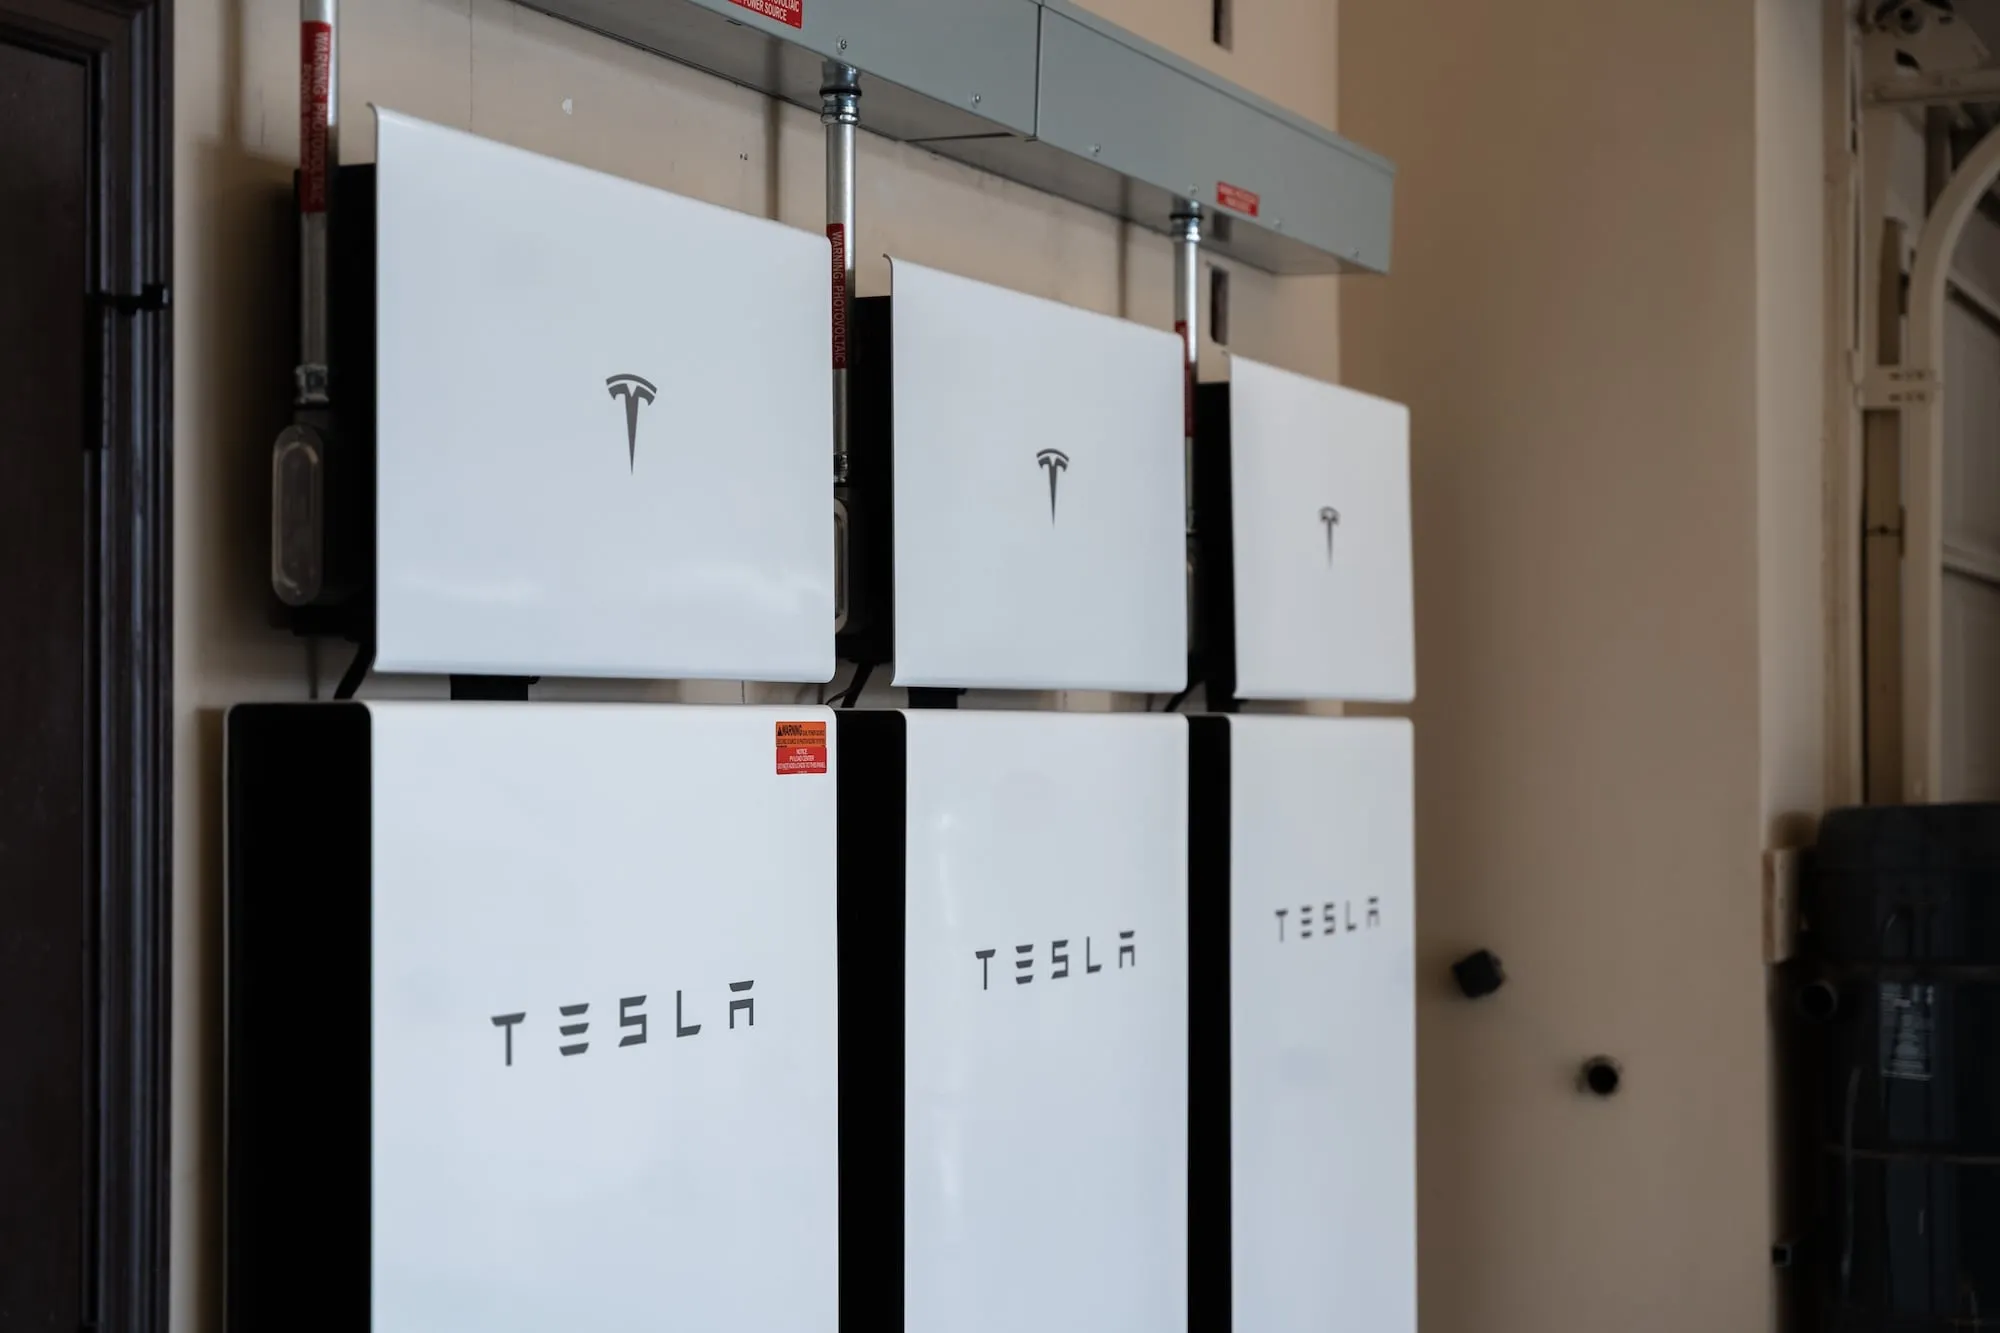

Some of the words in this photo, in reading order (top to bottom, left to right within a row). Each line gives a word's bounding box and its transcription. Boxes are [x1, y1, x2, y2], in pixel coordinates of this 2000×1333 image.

[764, 2, 787, 21] SOURCE
[833, 285, 846, 363] PHOTOVOLTAIC
[1275, 896, 1380, 943] TESLA
[975, 930, 1135, 990] TESLA
[491, 980, 754, 1066] TESLA
